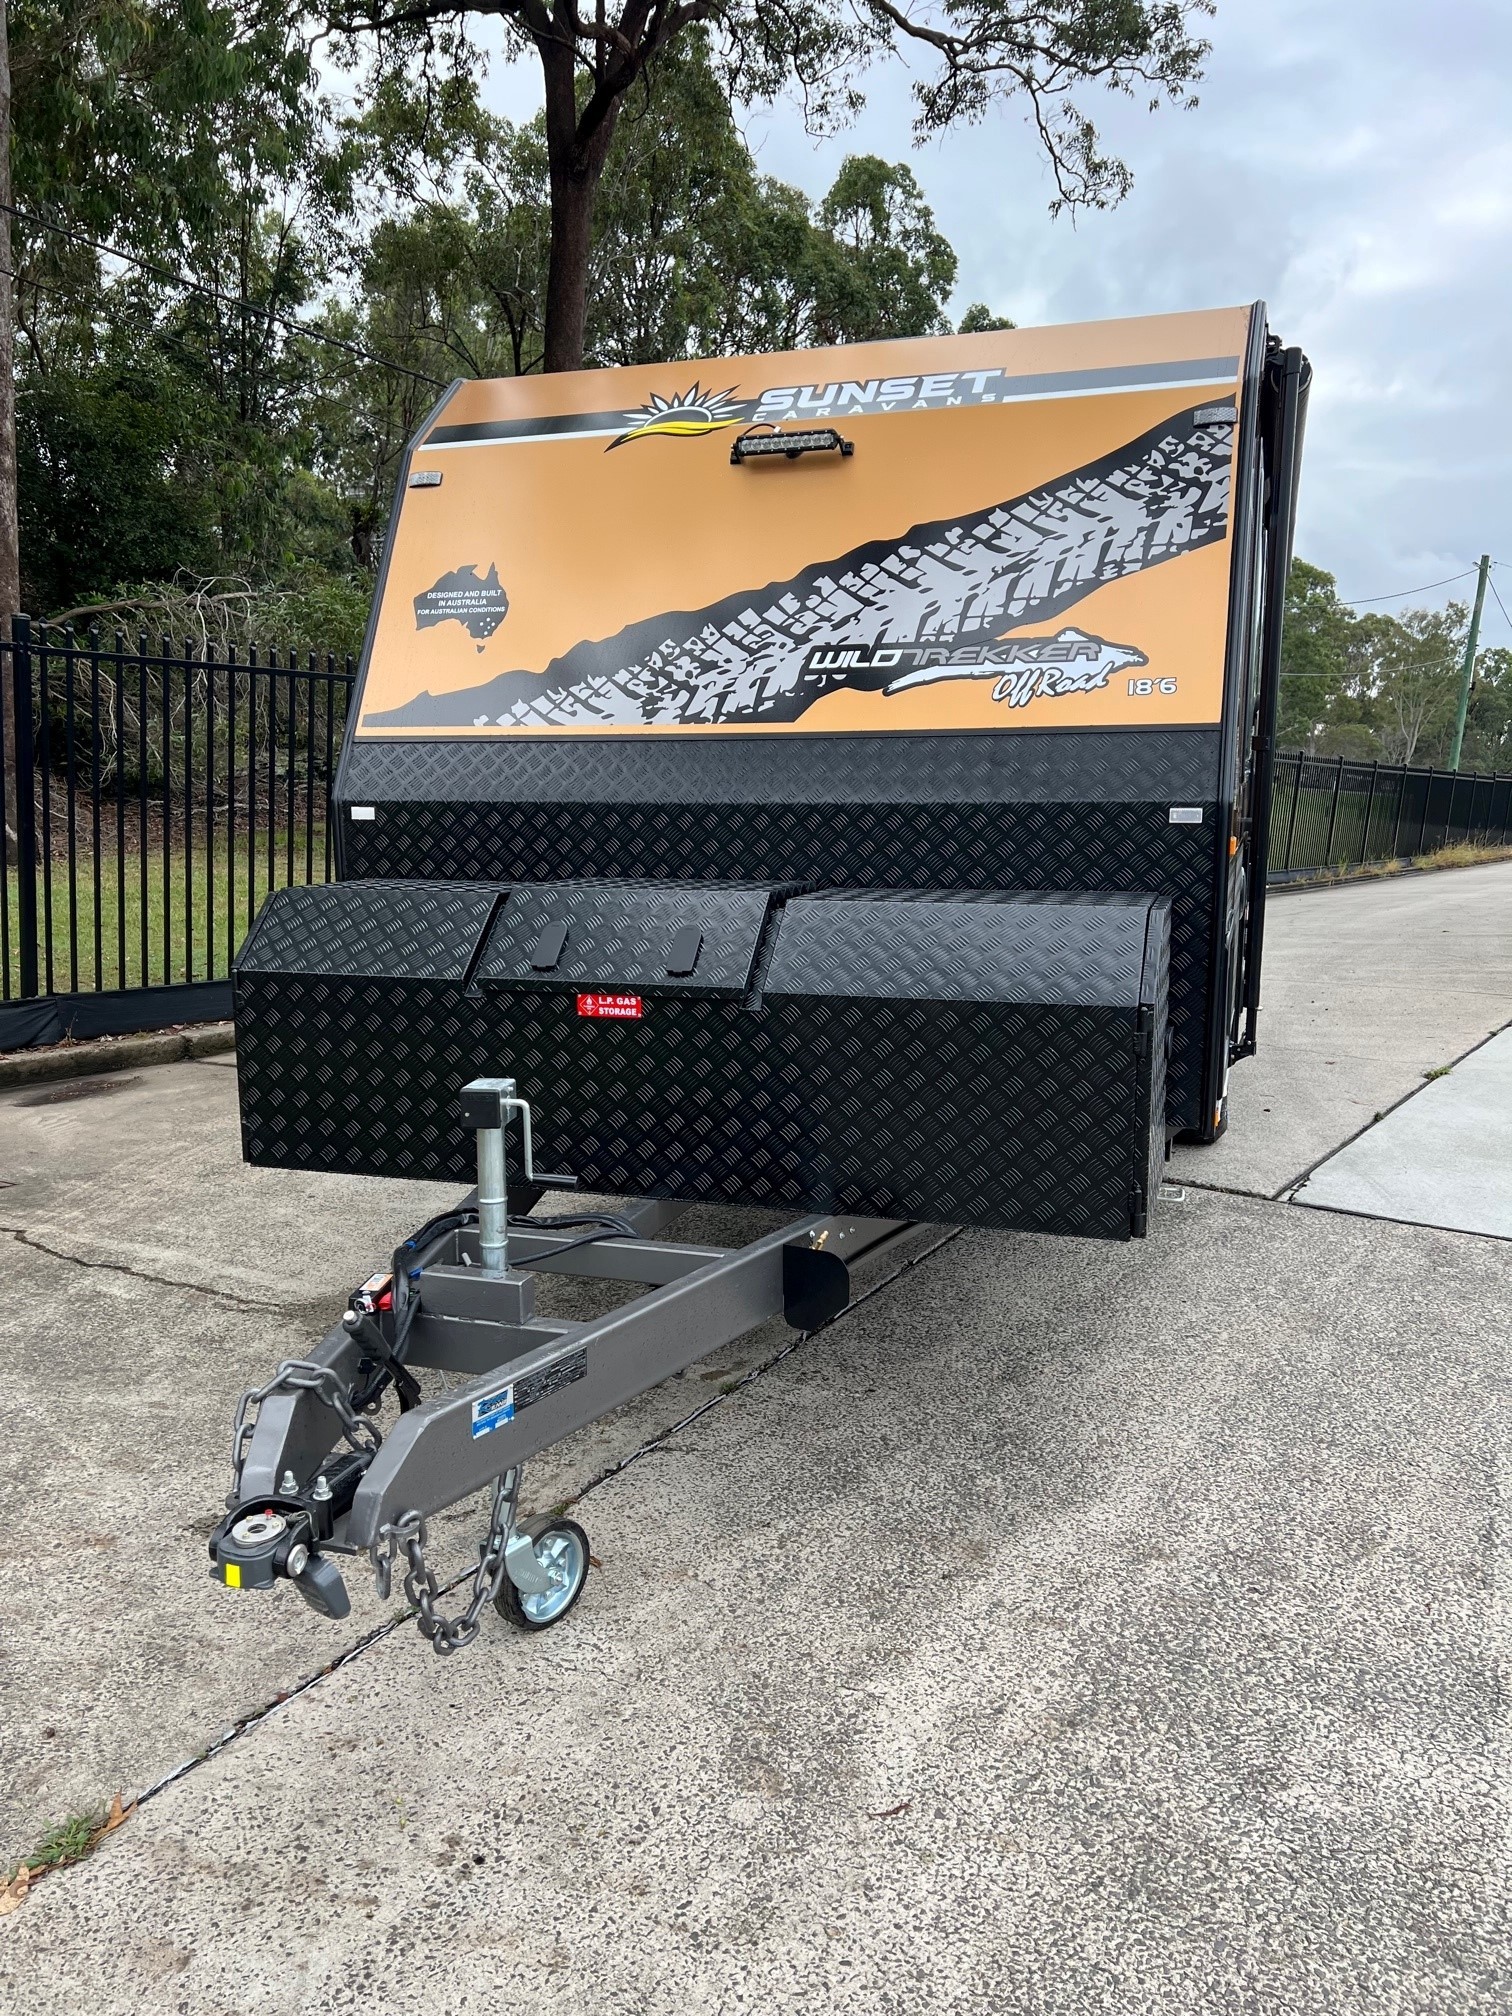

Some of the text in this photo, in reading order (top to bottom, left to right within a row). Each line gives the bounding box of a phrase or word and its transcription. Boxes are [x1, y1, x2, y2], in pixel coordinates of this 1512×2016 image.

[756, 370, 1002, 412] SUNSET
[751, 393, 997, 422] CARAVANS
[598, 996, 636, 1006] L.P. GAS
[598, 1007, 637, 1016] STORAGE
